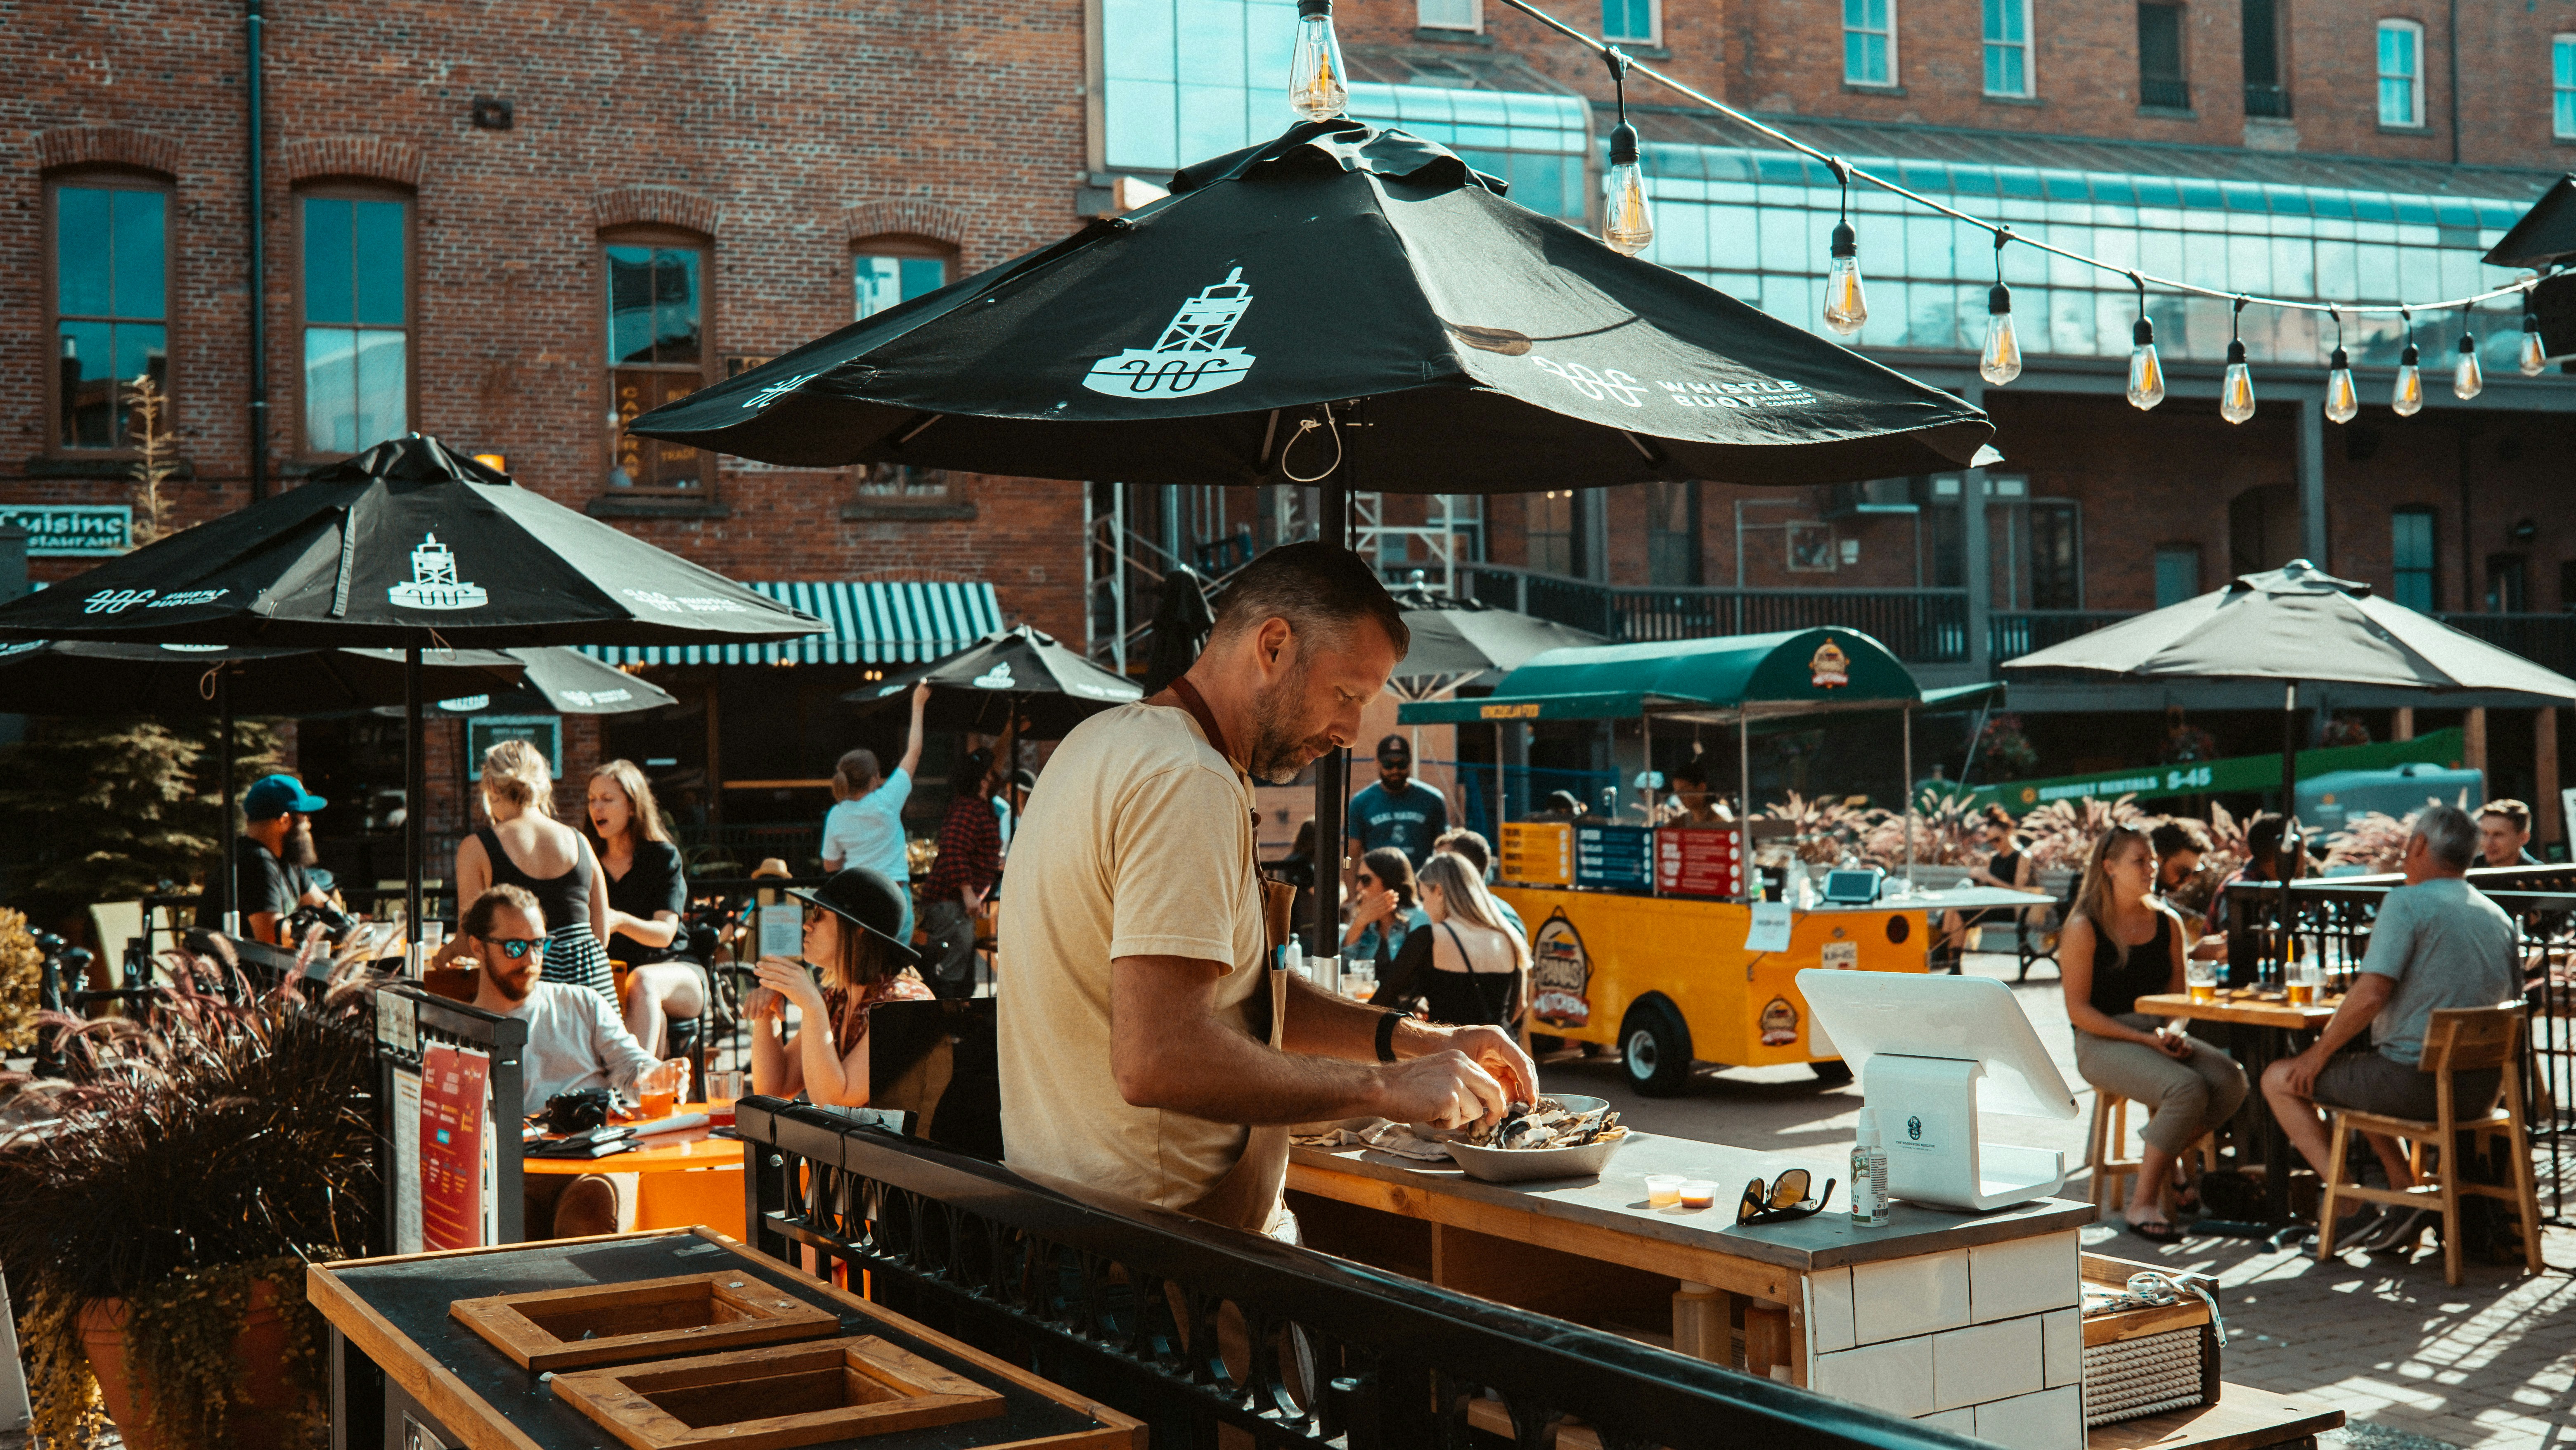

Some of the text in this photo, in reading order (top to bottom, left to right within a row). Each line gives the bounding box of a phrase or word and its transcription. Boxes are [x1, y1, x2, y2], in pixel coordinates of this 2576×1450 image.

[1655, 380, 1802, 394] WHISTLE
[1671, 393, 1813, 408] BUOY BREWING
[1766, 398, 1816, 407] COMPANY
[622, 386, 639, 478] CAMRAS
[2167, 767, 2212, 790] S-45
